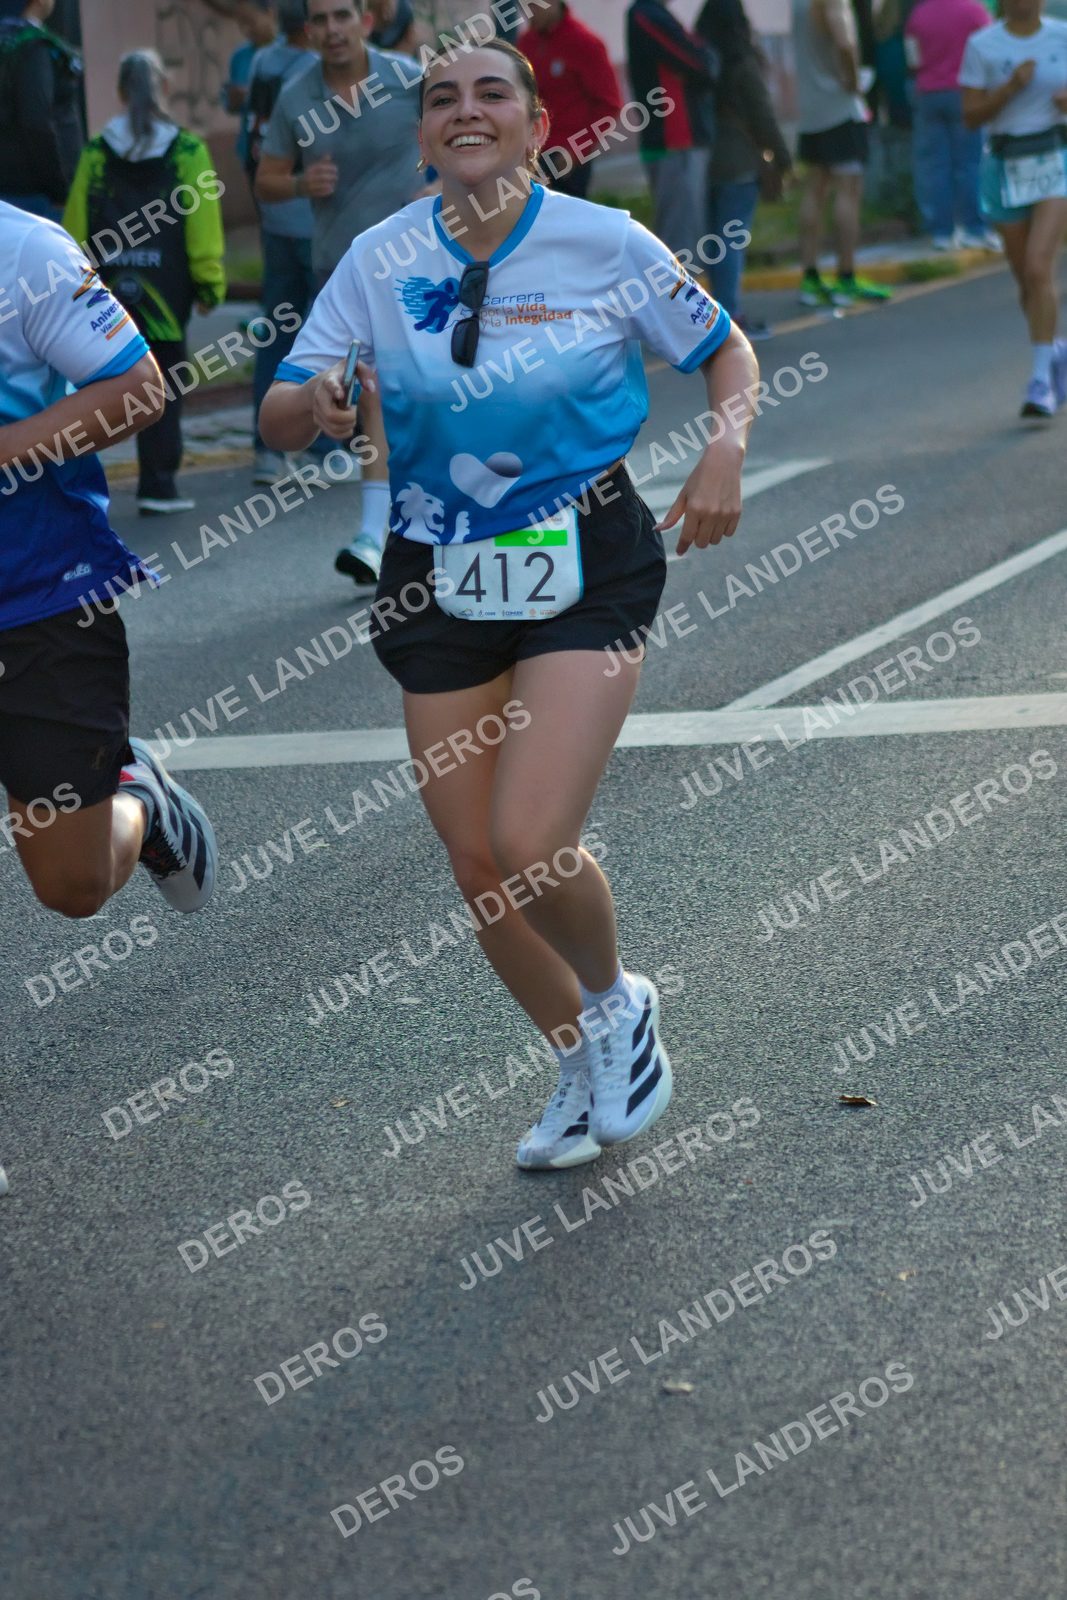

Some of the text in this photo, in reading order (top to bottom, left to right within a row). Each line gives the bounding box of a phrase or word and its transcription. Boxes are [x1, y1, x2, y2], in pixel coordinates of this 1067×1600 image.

[516, 303, 547, 313] Vida
[505, 310, 573, 326] Integridad
[455, 552, 556, 603] 412
